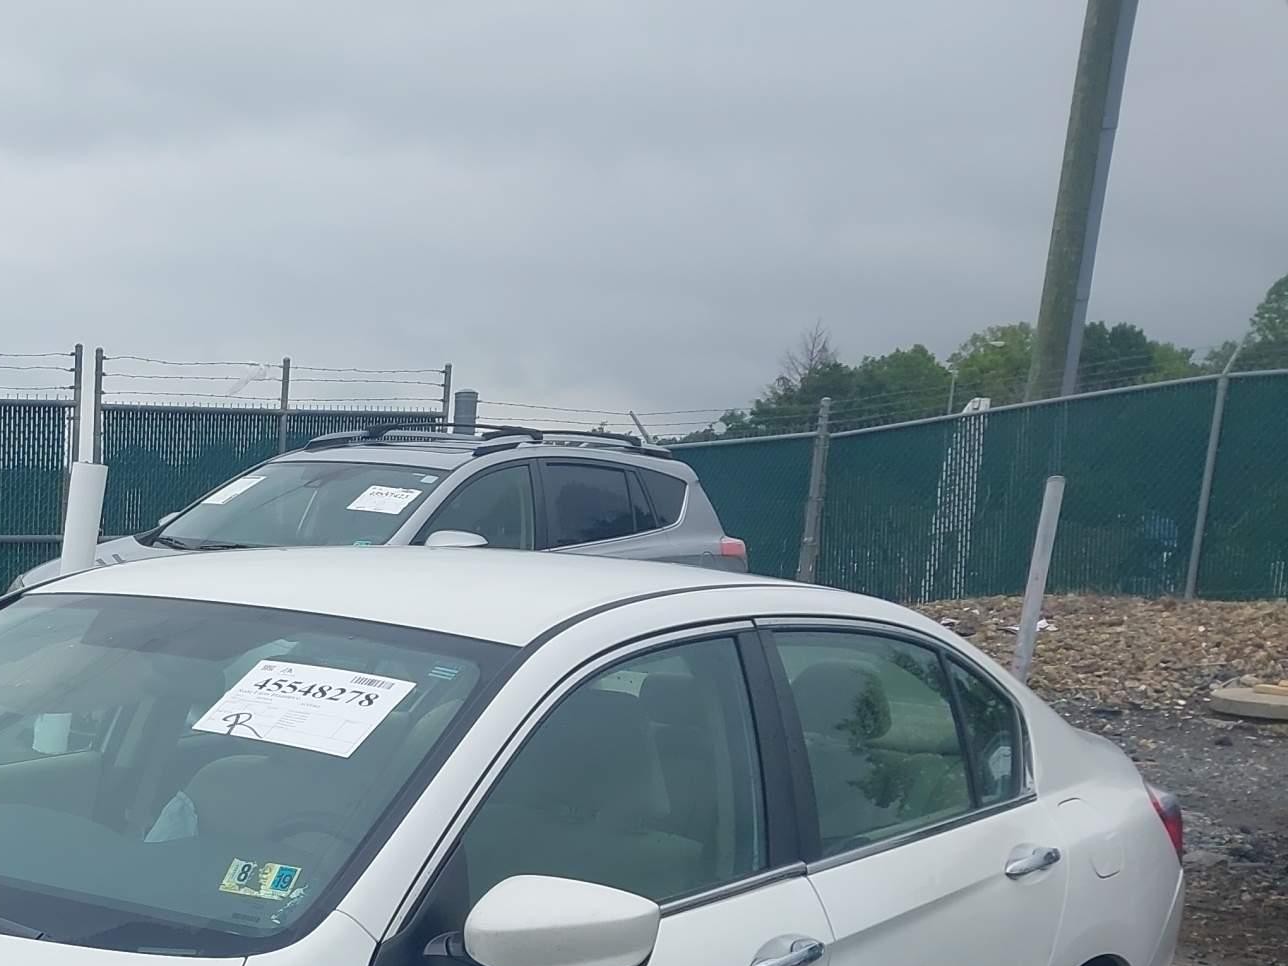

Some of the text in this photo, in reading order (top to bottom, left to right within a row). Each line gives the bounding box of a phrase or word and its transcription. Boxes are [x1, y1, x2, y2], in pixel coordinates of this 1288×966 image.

[254, 678, 379, 707] 45548278
[222, 712, 263, 738] R
[236, 863, 252, 882] 8
[273, 872, 294, 889] 19
